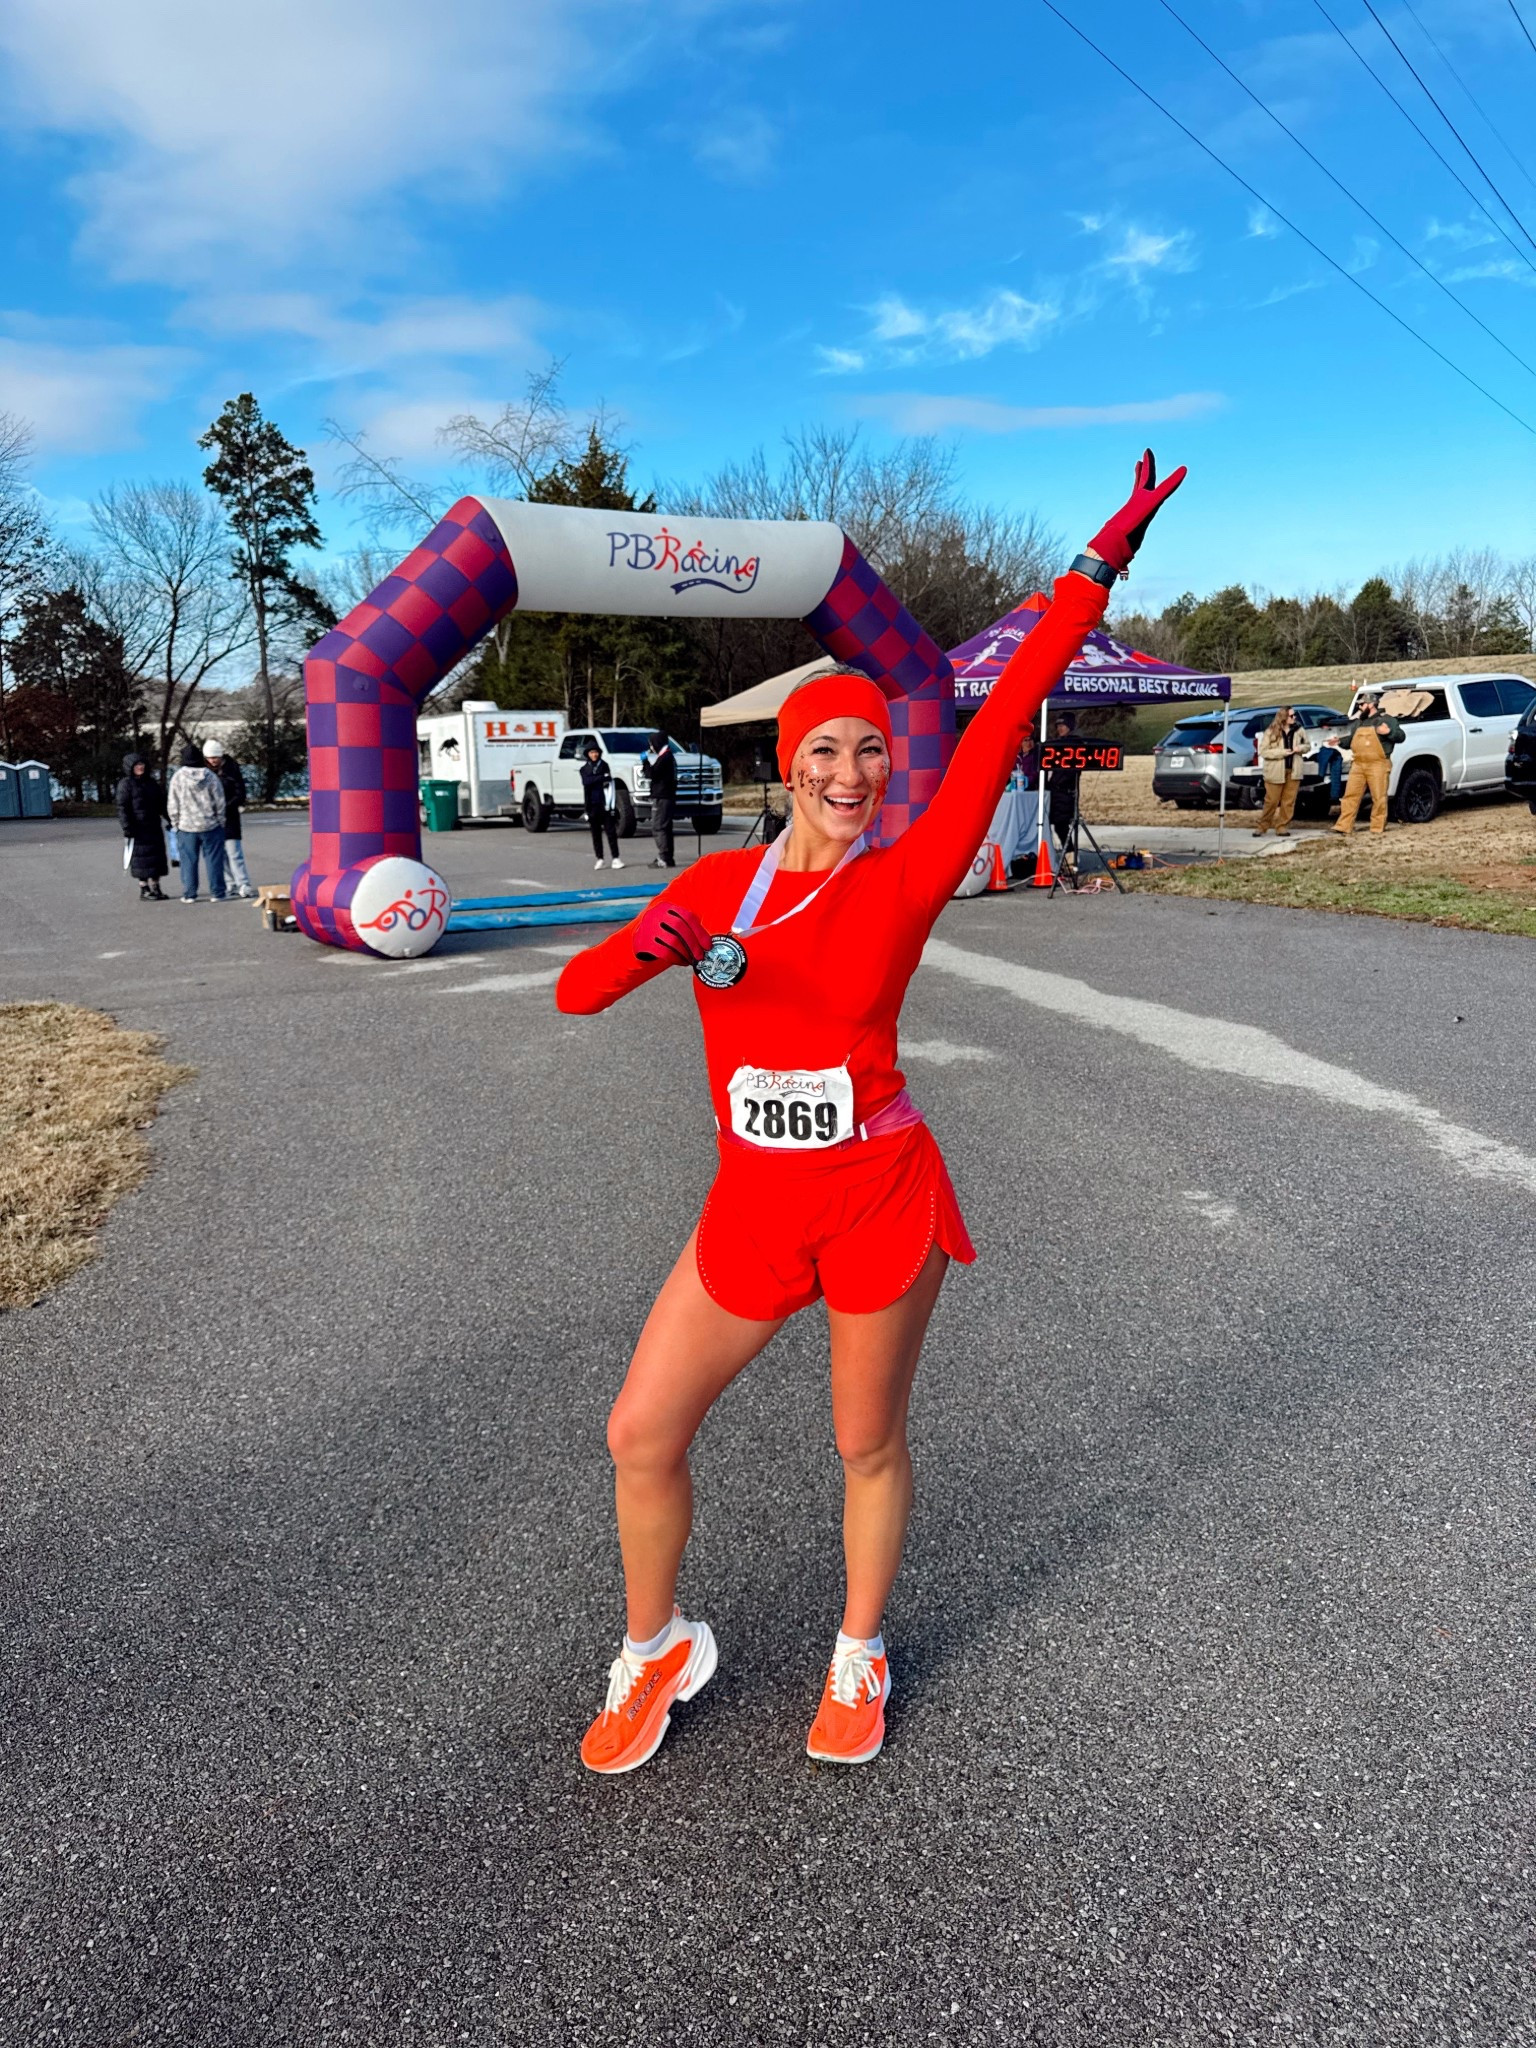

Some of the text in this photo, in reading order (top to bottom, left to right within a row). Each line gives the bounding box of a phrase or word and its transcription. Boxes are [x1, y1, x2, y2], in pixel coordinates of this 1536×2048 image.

[1064, 676, 1220, 697] PERSONAL BEST RACING
[484, 721, 557, 738] H & H
[744, 1097, 838, 1141] 2869
